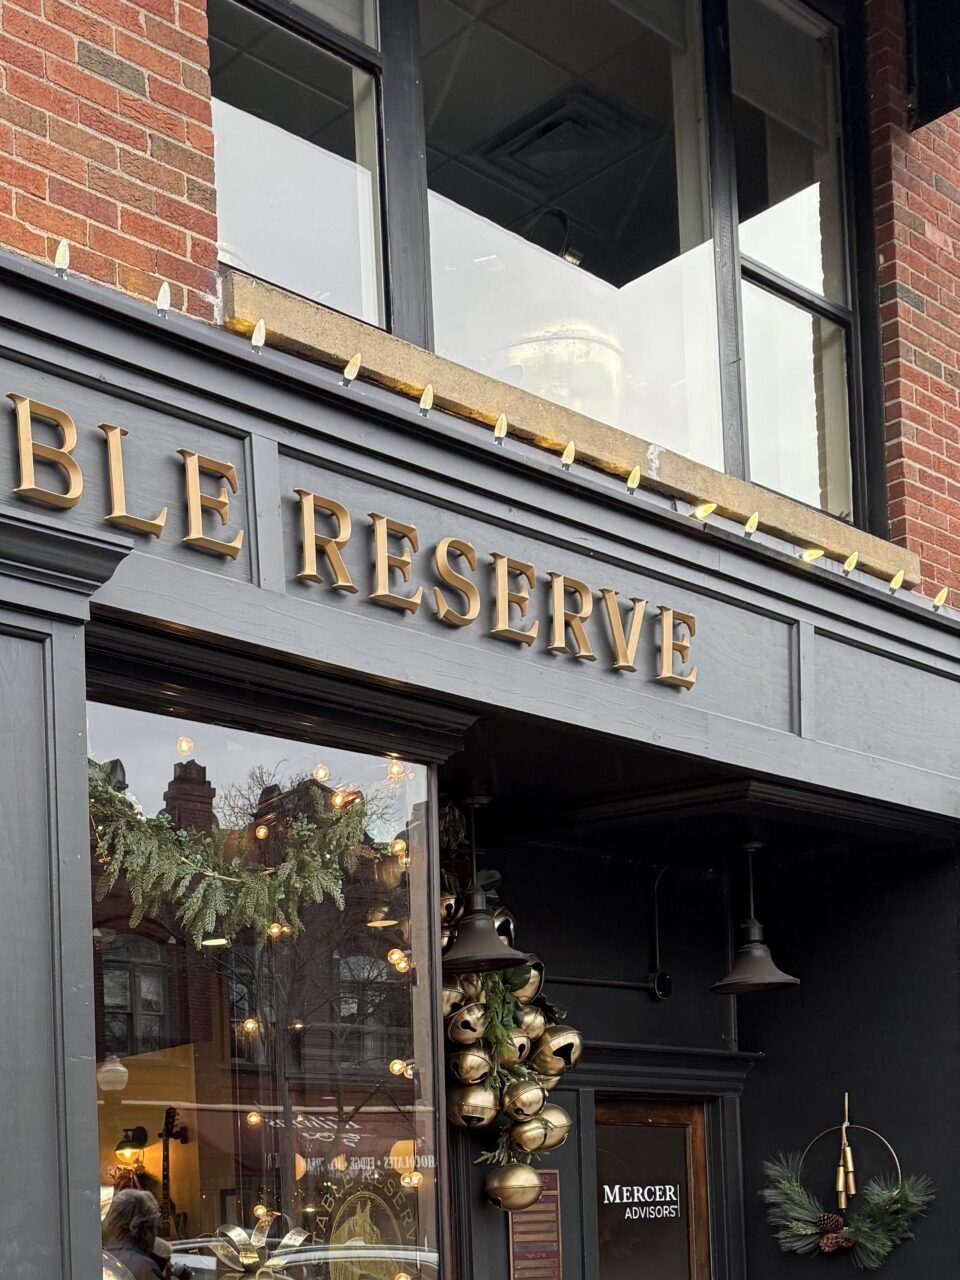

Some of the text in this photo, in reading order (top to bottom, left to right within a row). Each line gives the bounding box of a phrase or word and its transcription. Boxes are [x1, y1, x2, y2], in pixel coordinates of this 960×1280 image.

[293, 487, 698, 691] RESERVE
[603, 1184, 677, 1204] MERCER
[624, 1205, 677, 1220] ADVISORS
